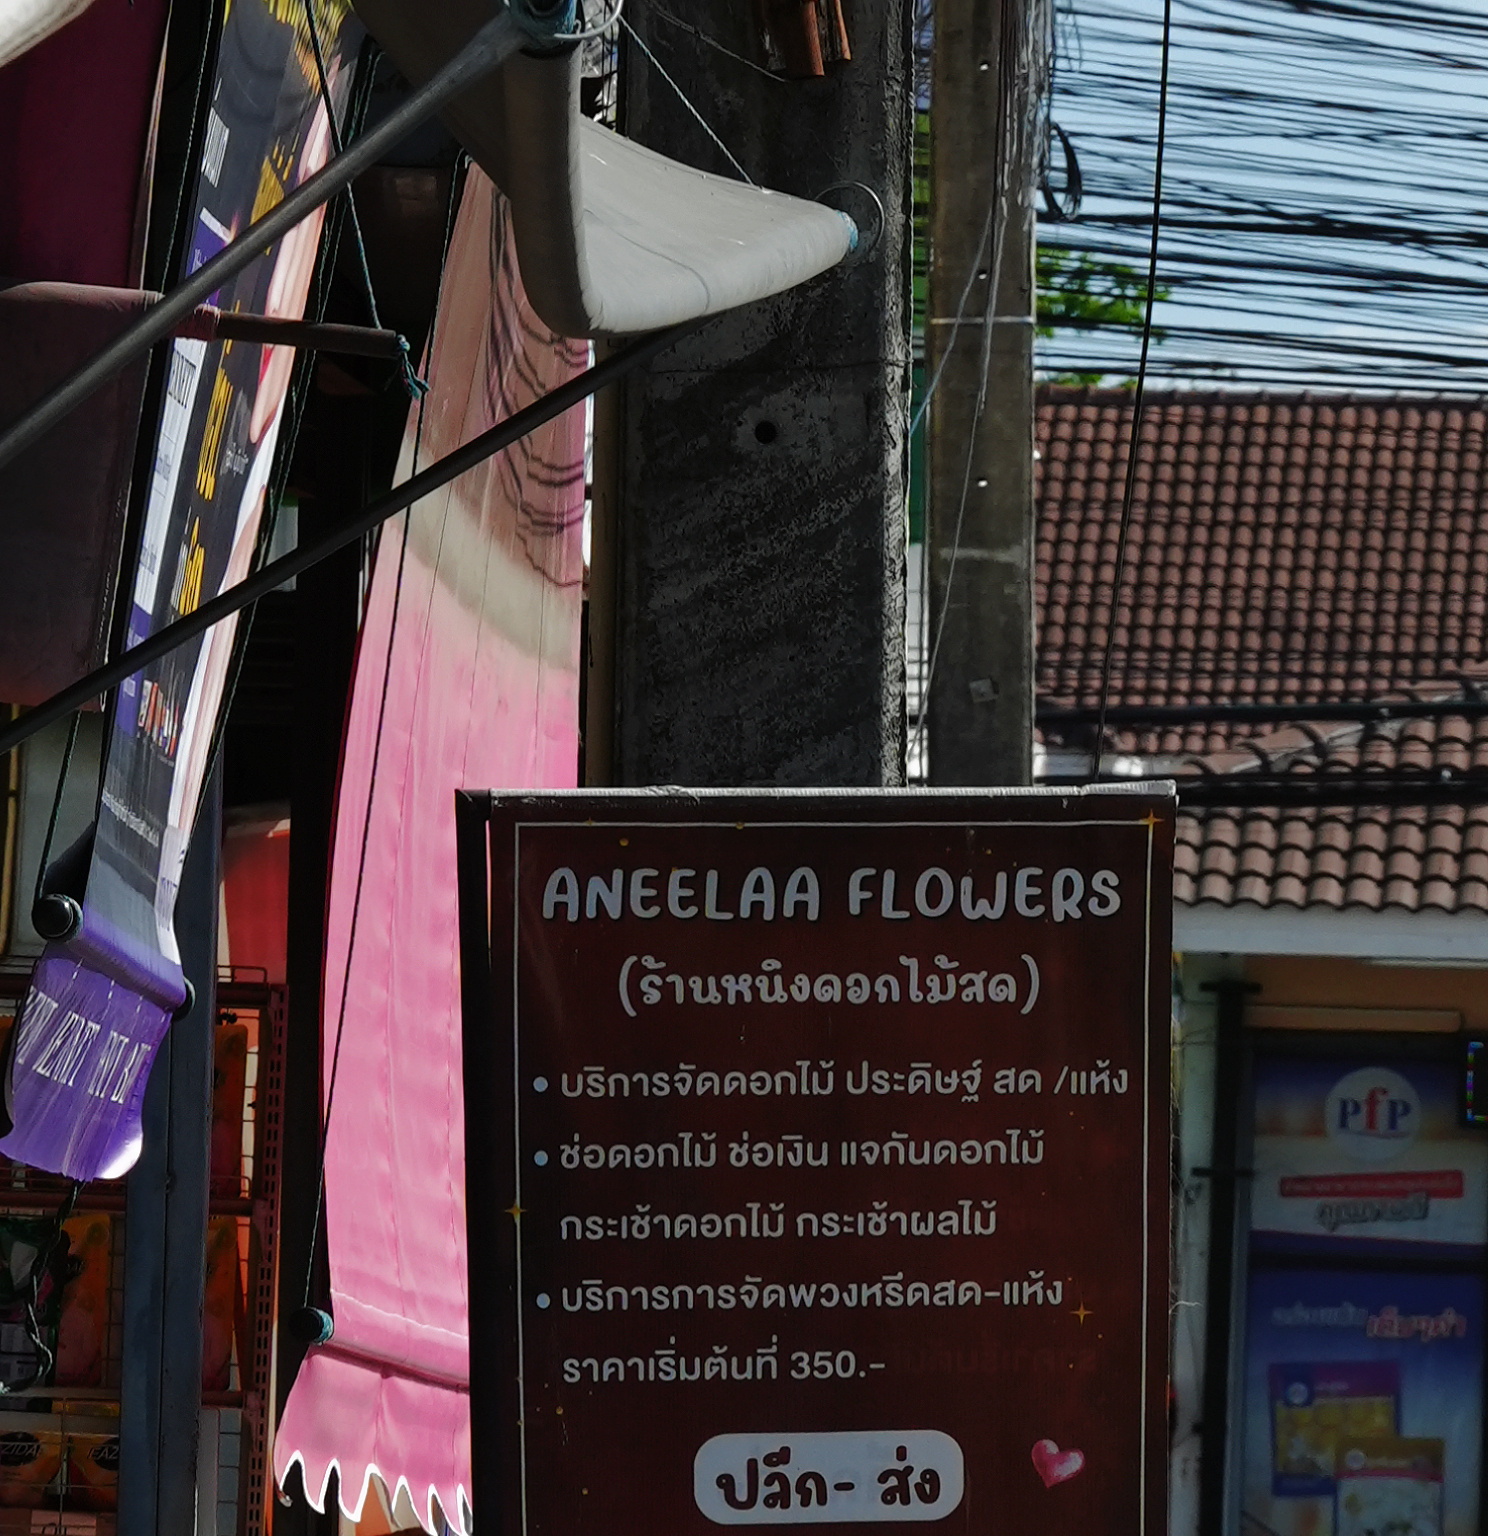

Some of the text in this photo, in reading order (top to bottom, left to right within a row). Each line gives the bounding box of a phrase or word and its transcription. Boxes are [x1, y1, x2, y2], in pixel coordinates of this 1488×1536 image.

[541, 866, 1122, 922] ANEELAA FLOWERS
[560, 1058, 1129, 1103] บริการจัดดอกไม้ ประดิษฐ์ สด /แห้ง
[560, 1129, 1045, 1169] ช่อดอกไม้ ช่อเงิน แจกันดอกไม้
[560, 1200, 998, 1240] กระเช้าดอกไม้ กระเช้าผลไม้
[561, 1270, 1064, 1312] บริการการจัดพวงหรีดสด-แห้ง
[562, 1335, 886, 1383] ราคาเริ่มต้นที่ 350.-
[877, 1445, 941, 1506] ส่ง
